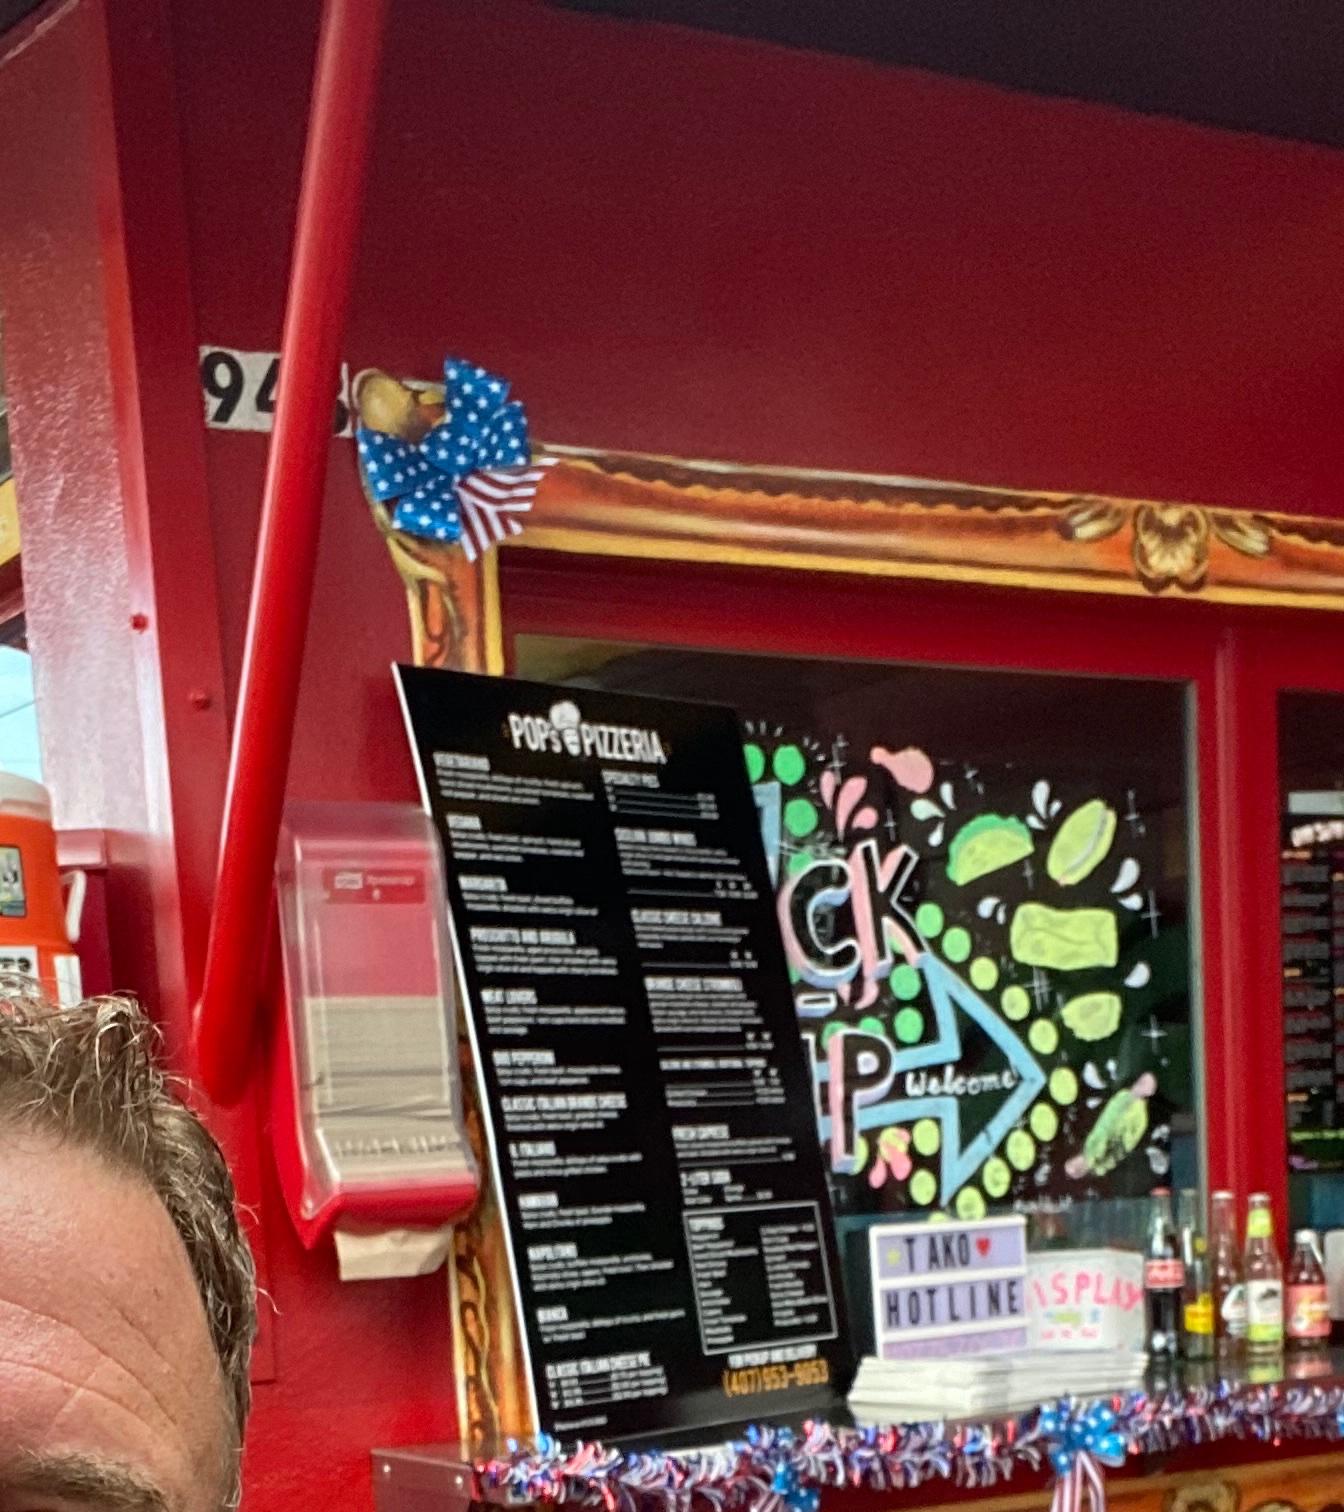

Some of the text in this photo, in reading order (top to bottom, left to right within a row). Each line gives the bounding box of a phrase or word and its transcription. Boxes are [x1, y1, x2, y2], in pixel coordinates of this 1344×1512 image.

[581, 722, 668, 765] PIZZERIA
[885, 1280, 1020, 1329] HOTLINE
[1027, 1270, 1145, 1313] ISPLAY
